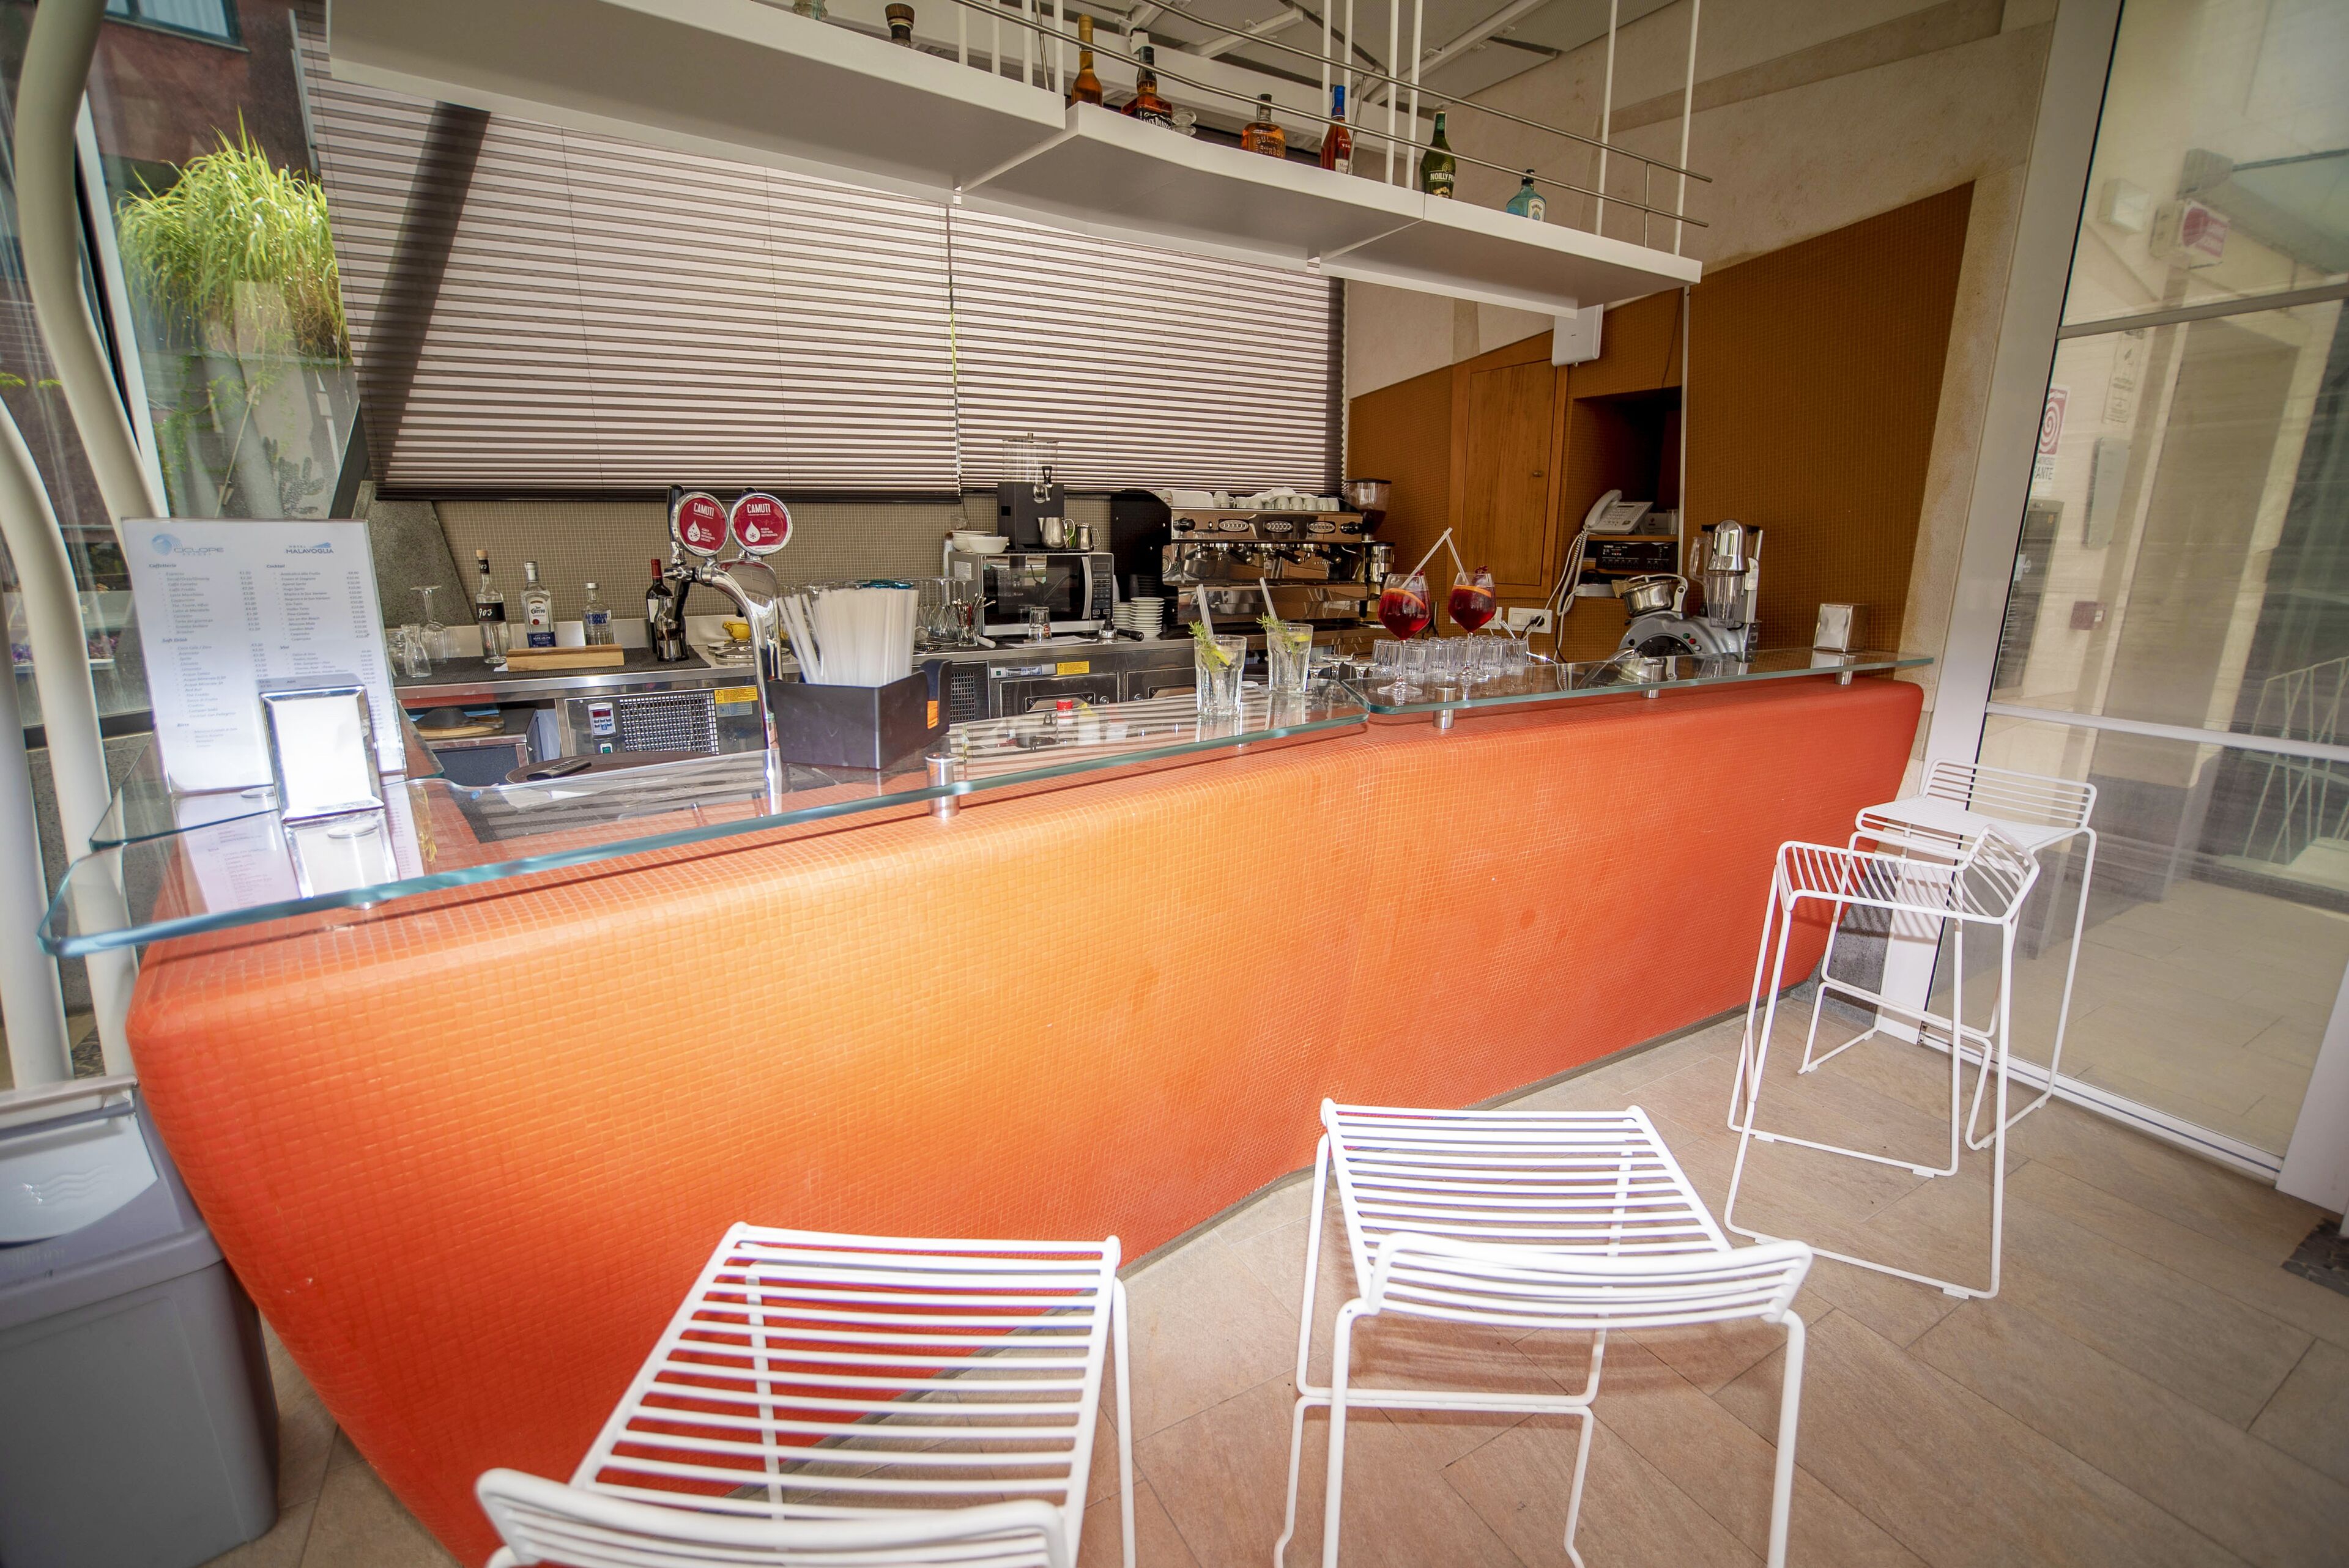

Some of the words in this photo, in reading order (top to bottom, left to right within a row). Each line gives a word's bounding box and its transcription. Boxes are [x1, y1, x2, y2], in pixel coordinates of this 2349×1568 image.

[693, 502, 714, 517] CAMUTI
[746, 503, 771, 514] CAMUTI
[478, 608, 492, 619] 903
